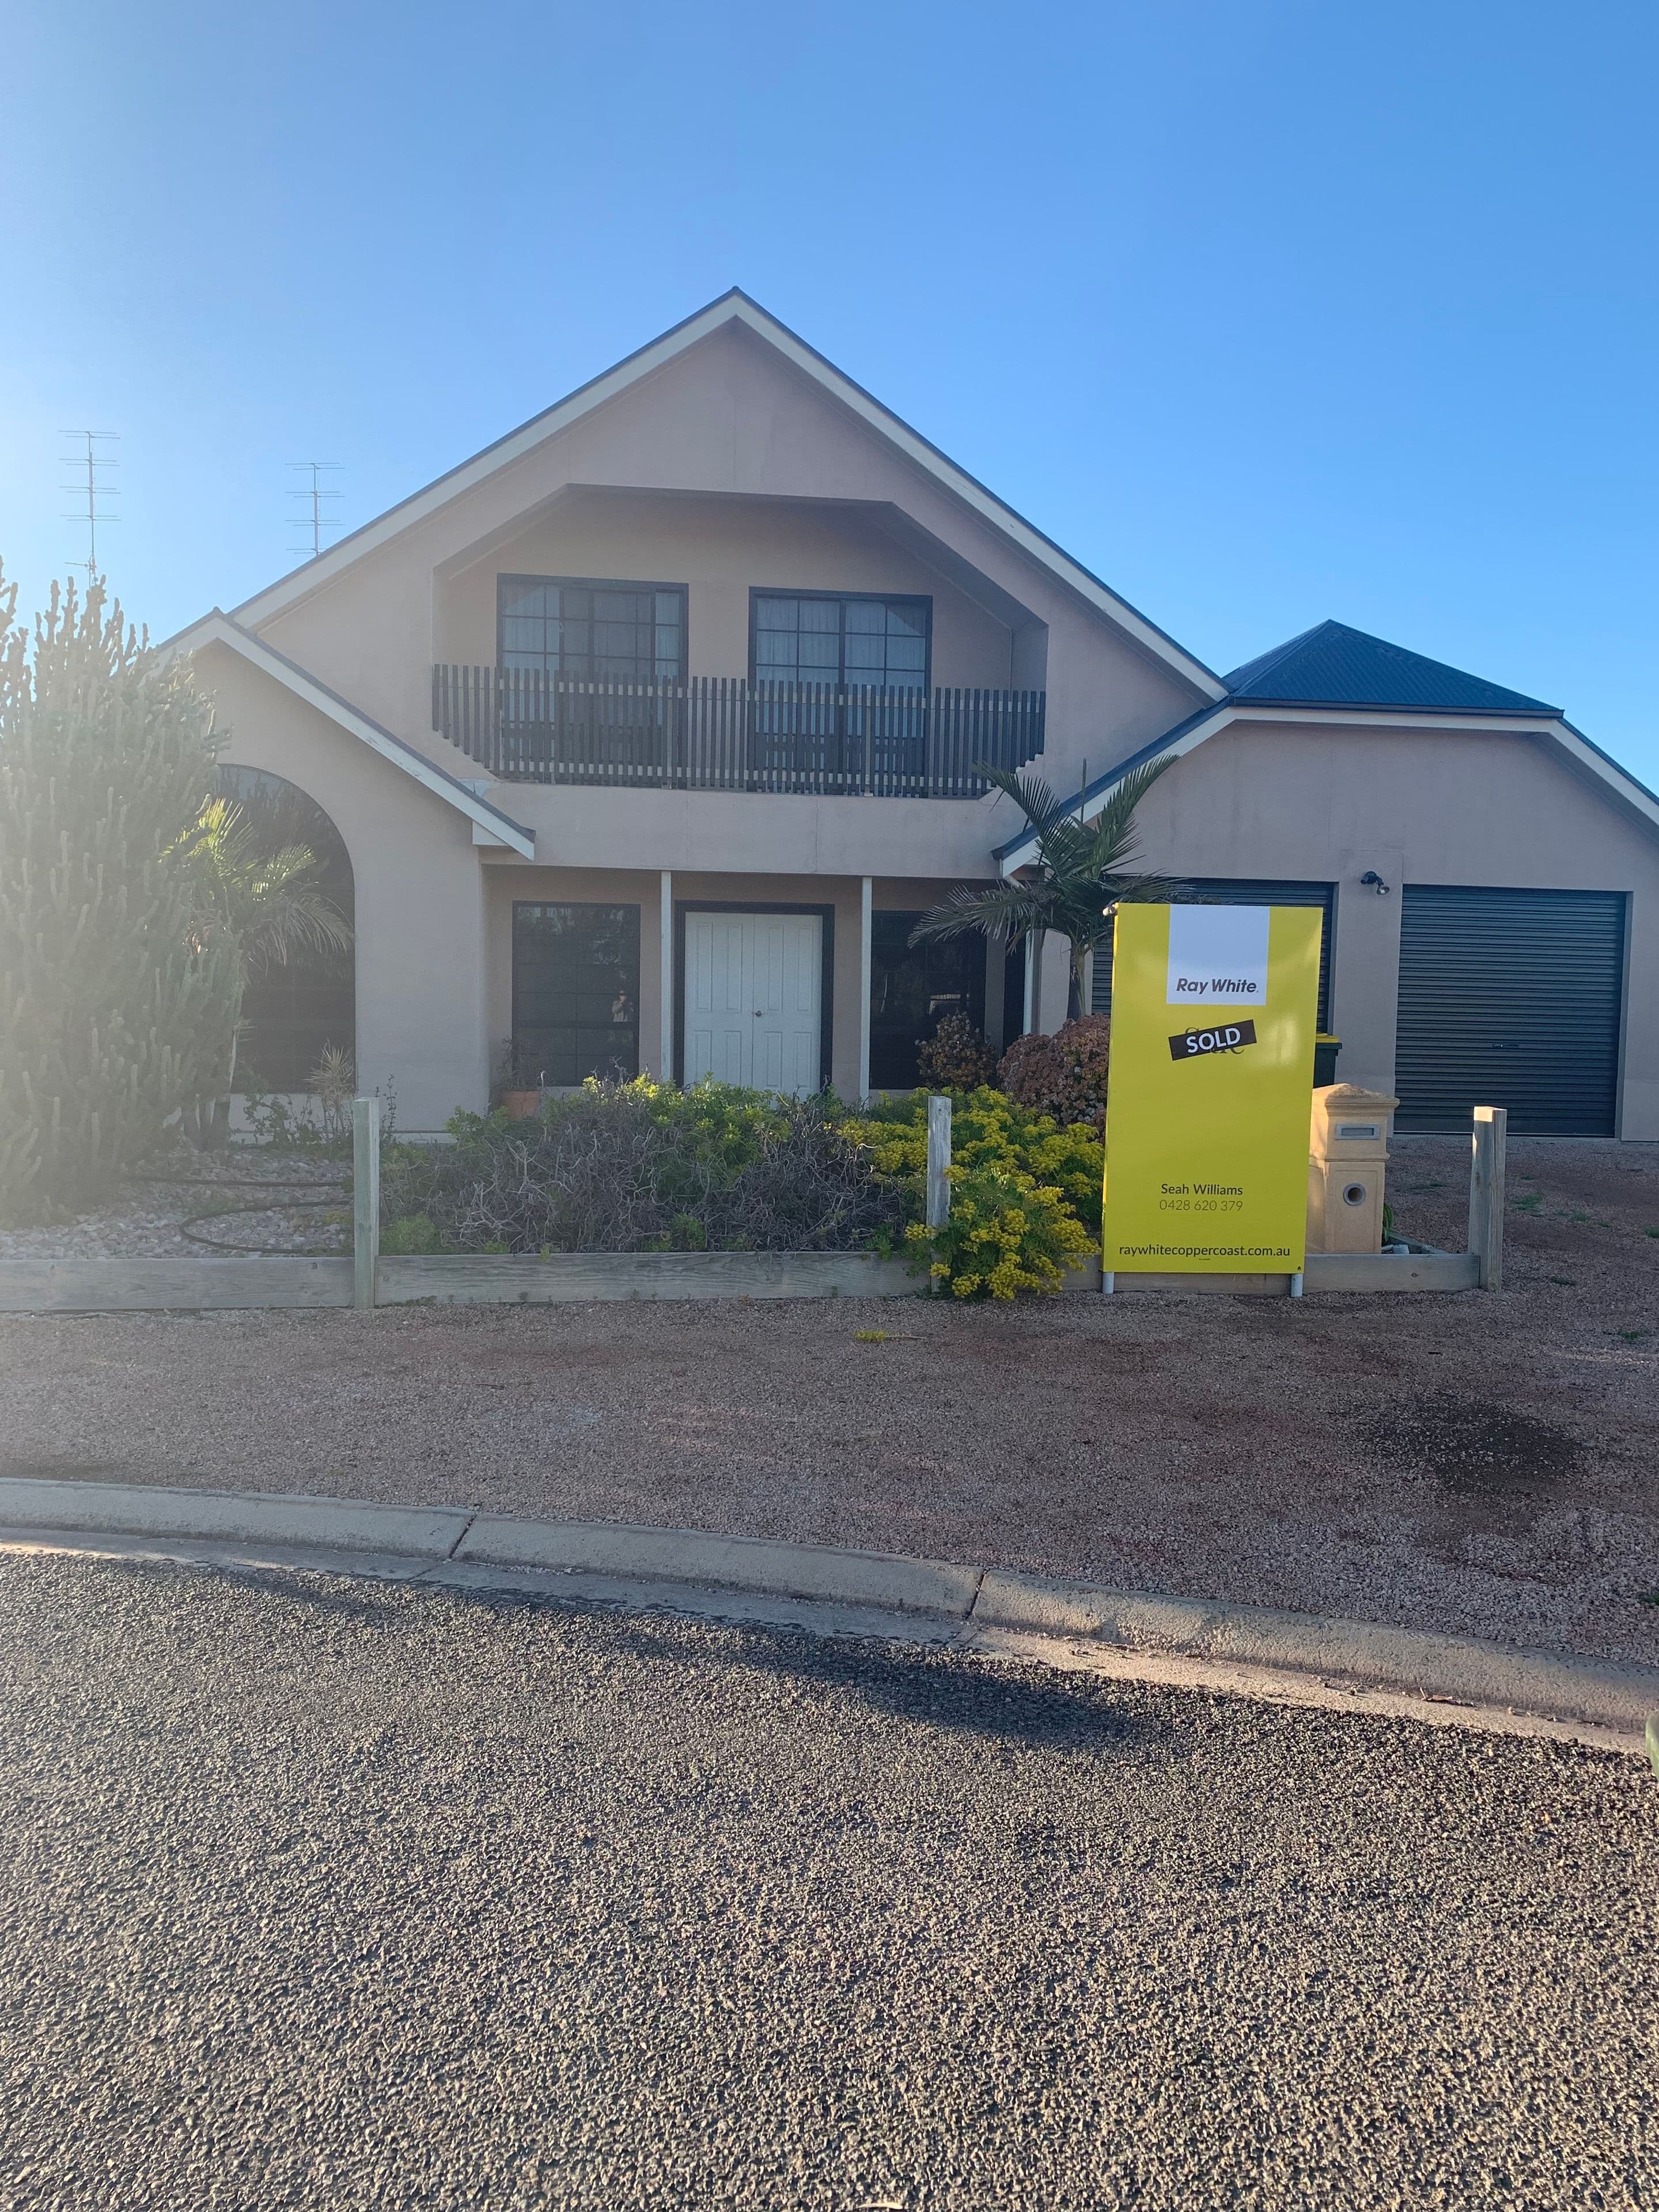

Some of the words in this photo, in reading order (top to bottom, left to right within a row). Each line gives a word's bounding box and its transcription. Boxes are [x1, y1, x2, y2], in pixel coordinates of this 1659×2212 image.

[1176, 978, 1209, 995] Ray
[1185, 1027, 1241, 1054] SOLD
[1161, 1183, 1189, 1195] Seah
[1194, 1184, 1243, 1196] Williams
[1159, 1199, 1190, 1210] 0428
[1194, 1199, 1217, 1211] 620
[1221, 1200, 1243, 1212] 379
[1119, 1244, 1290, 1257] raywhitecoppercoast.com.au
